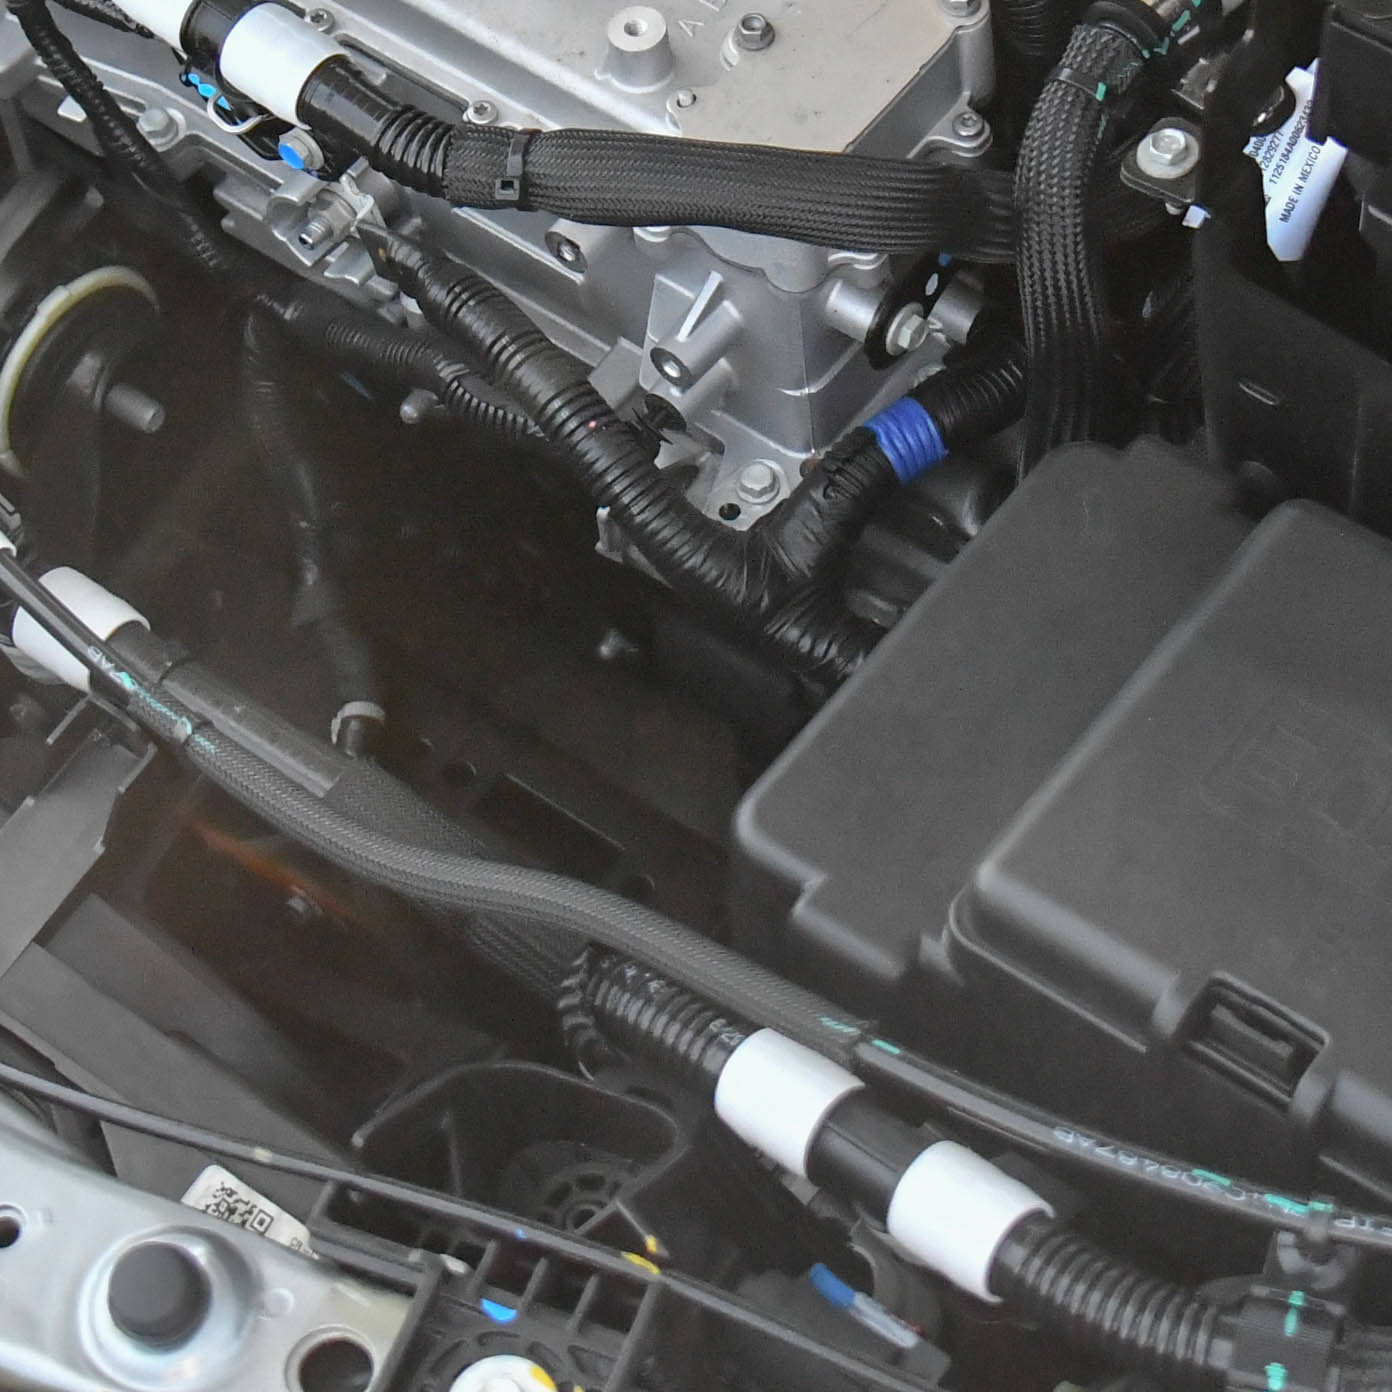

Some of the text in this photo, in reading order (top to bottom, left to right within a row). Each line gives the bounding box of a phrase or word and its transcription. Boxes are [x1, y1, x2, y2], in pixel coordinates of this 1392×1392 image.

[677, 19, 705, 38] A
[1279, 144, 1322, 222] MADE IN MEXICO
